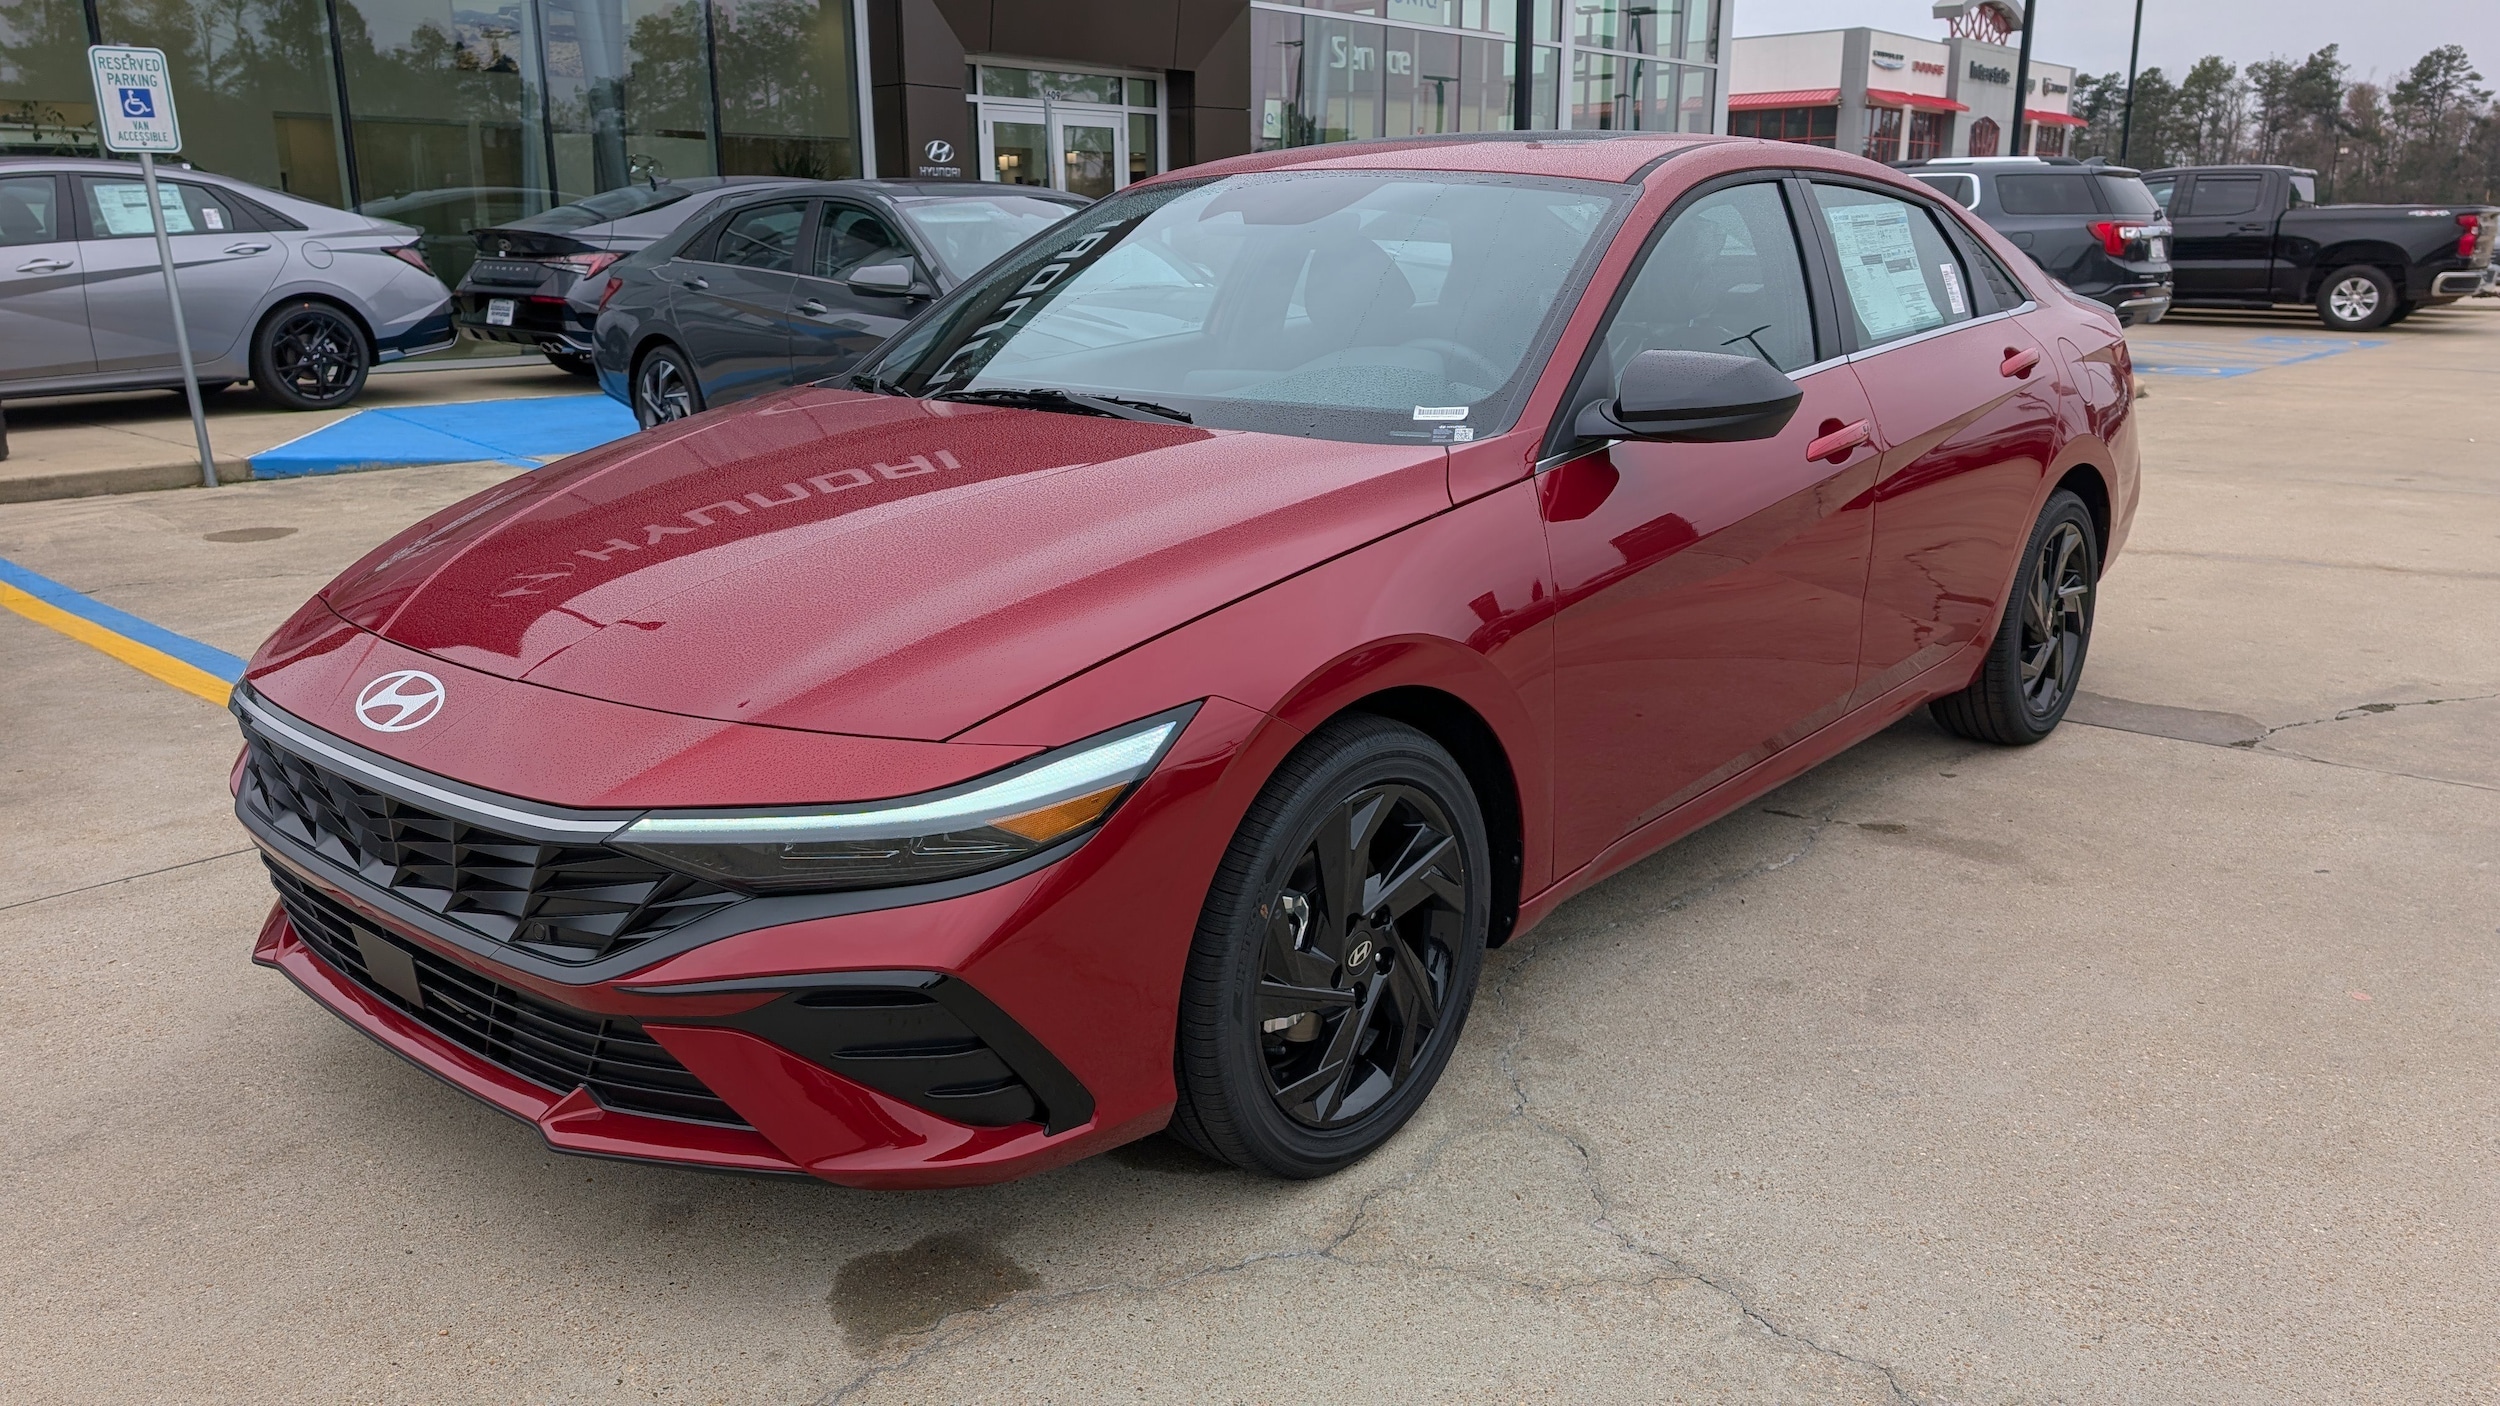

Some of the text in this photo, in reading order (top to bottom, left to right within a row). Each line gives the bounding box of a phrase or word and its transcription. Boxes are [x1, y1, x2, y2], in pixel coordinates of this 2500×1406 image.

[98, 56, 160, 72] RESERVED
[107, 72, 158, 87] PARKING
[132, 121, 150, 131] VAN
[118, 131, 168, 142] ACCESSIBLE
[919, 166, 961, 177] HYUNDAI
